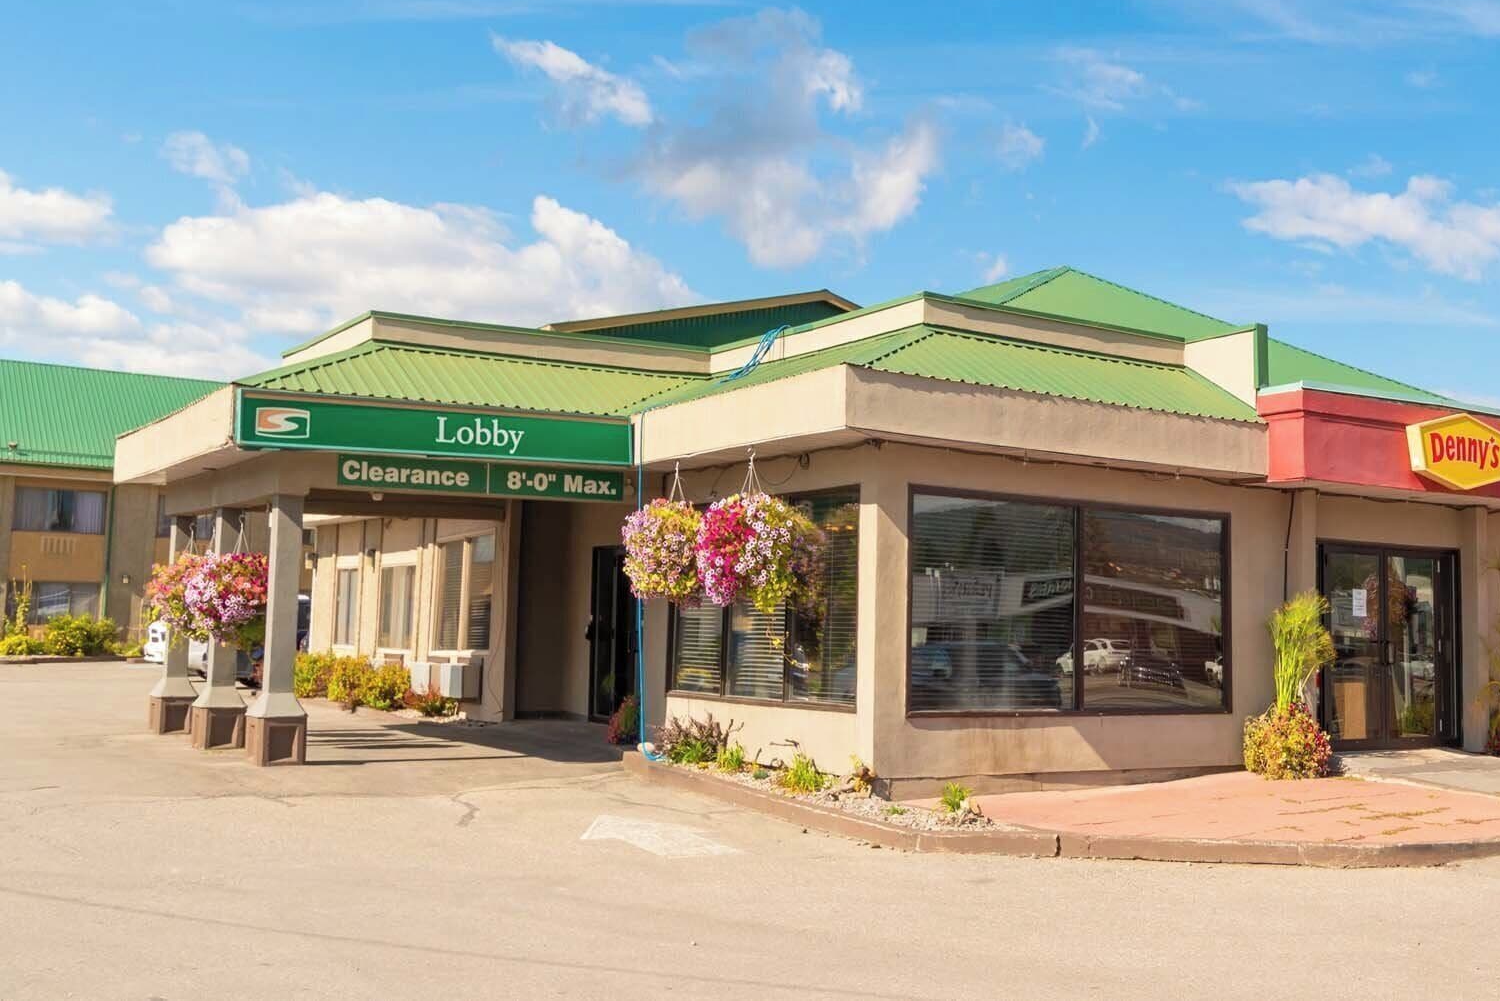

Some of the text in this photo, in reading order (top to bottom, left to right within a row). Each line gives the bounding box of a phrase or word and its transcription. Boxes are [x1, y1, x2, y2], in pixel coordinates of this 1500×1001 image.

[435, 416, 525, 454] Lobby
[1430, 432, 1500, 470] Denny's
[342, 459, 470, 487] Clearance
[564, 473, 617, 496] Max.
